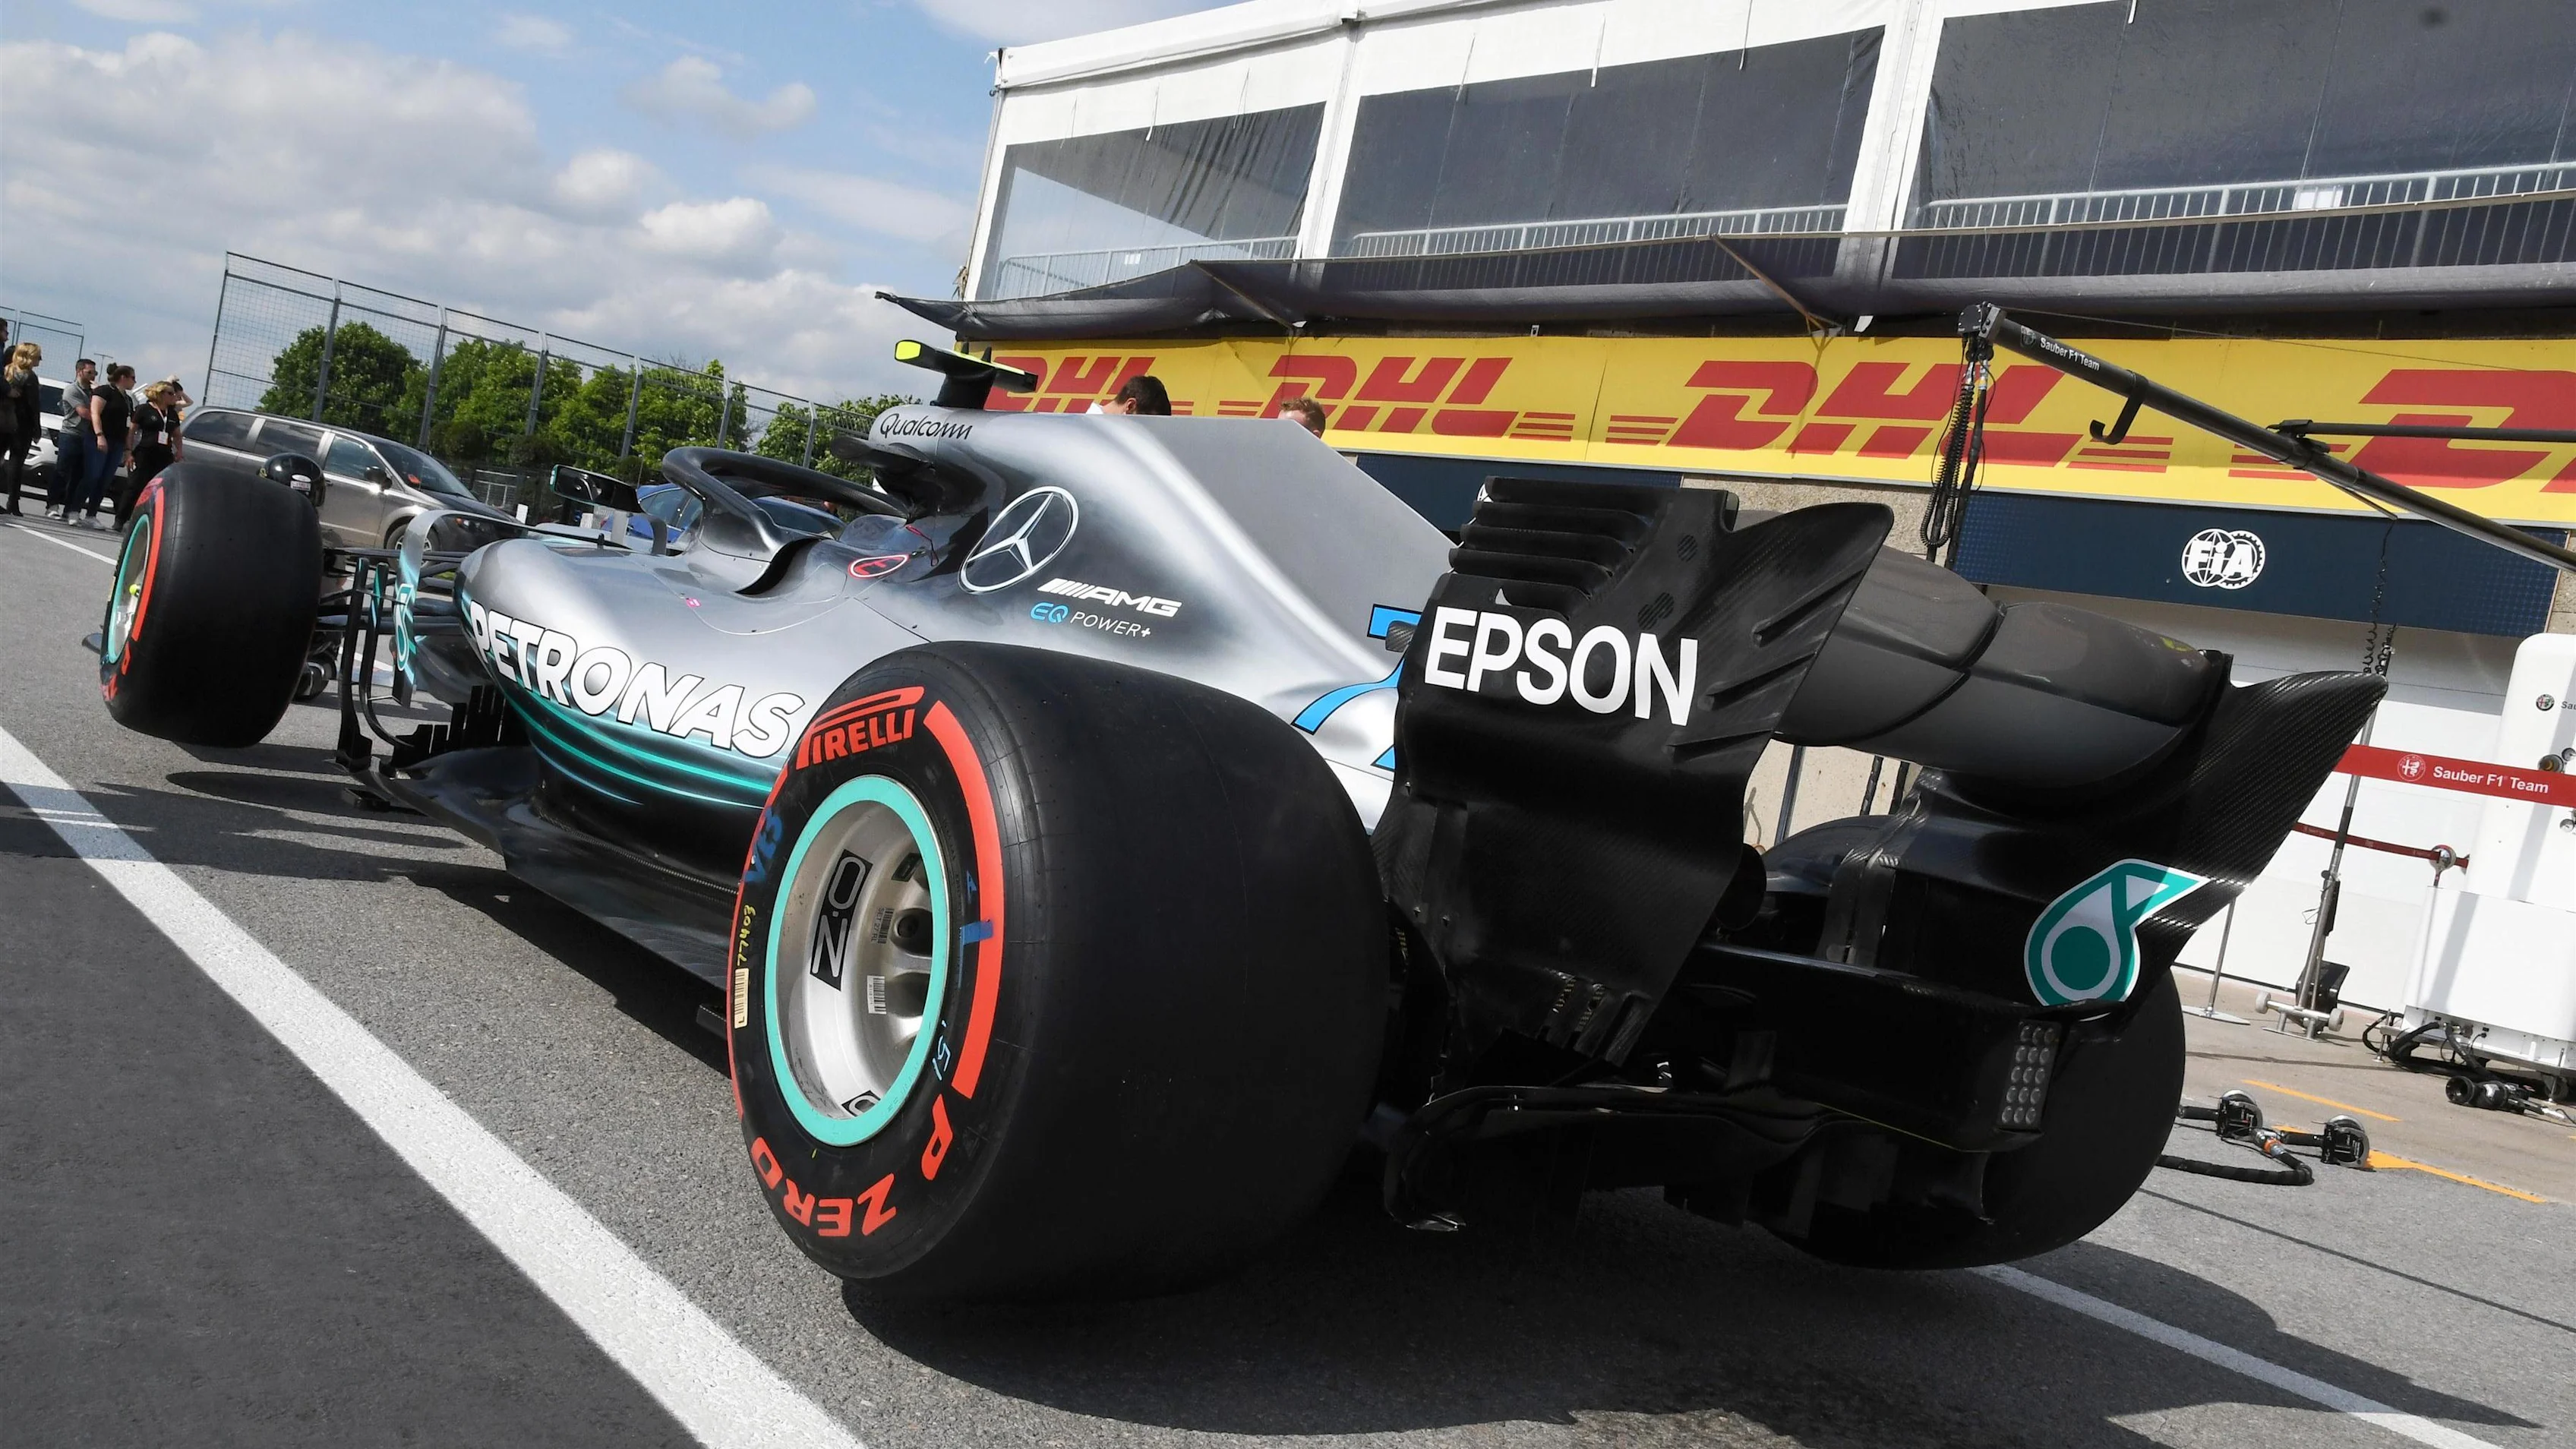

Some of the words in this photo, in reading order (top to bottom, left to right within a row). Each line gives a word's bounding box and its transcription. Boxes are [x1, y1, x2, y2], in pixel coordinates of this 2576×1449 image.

[2041, 337, 2068, 358] Sauber
[2069, 349, 2079, 362] F1
[2079, 353, 2100, 371] Team
[880, 413, 973, 440] Qualcomm
[1259, 355, 1513, 438] DHL
[1667, 361, 2083, 467] DHL
[1030, 601, 1069, 623] EQ
[1070, 611, 1151, 638] POWER+
[1074, 586, 1182, 617] AMG
[469, 600, 805, 758] PETRONAS
[1424, 606, 1698, 726] EPSON
[796, 686, 924, 770] PIRELLI
[2432, 766, 2483, 784] Sauber
[2486, 774, 2503, 788] F1
[2510, 776, 2549, 794] Team
[737, 904, 756, 966] 77403
[921, 1094, 953, 1181] P
[751, 1137, 897, 1237] ZERO
